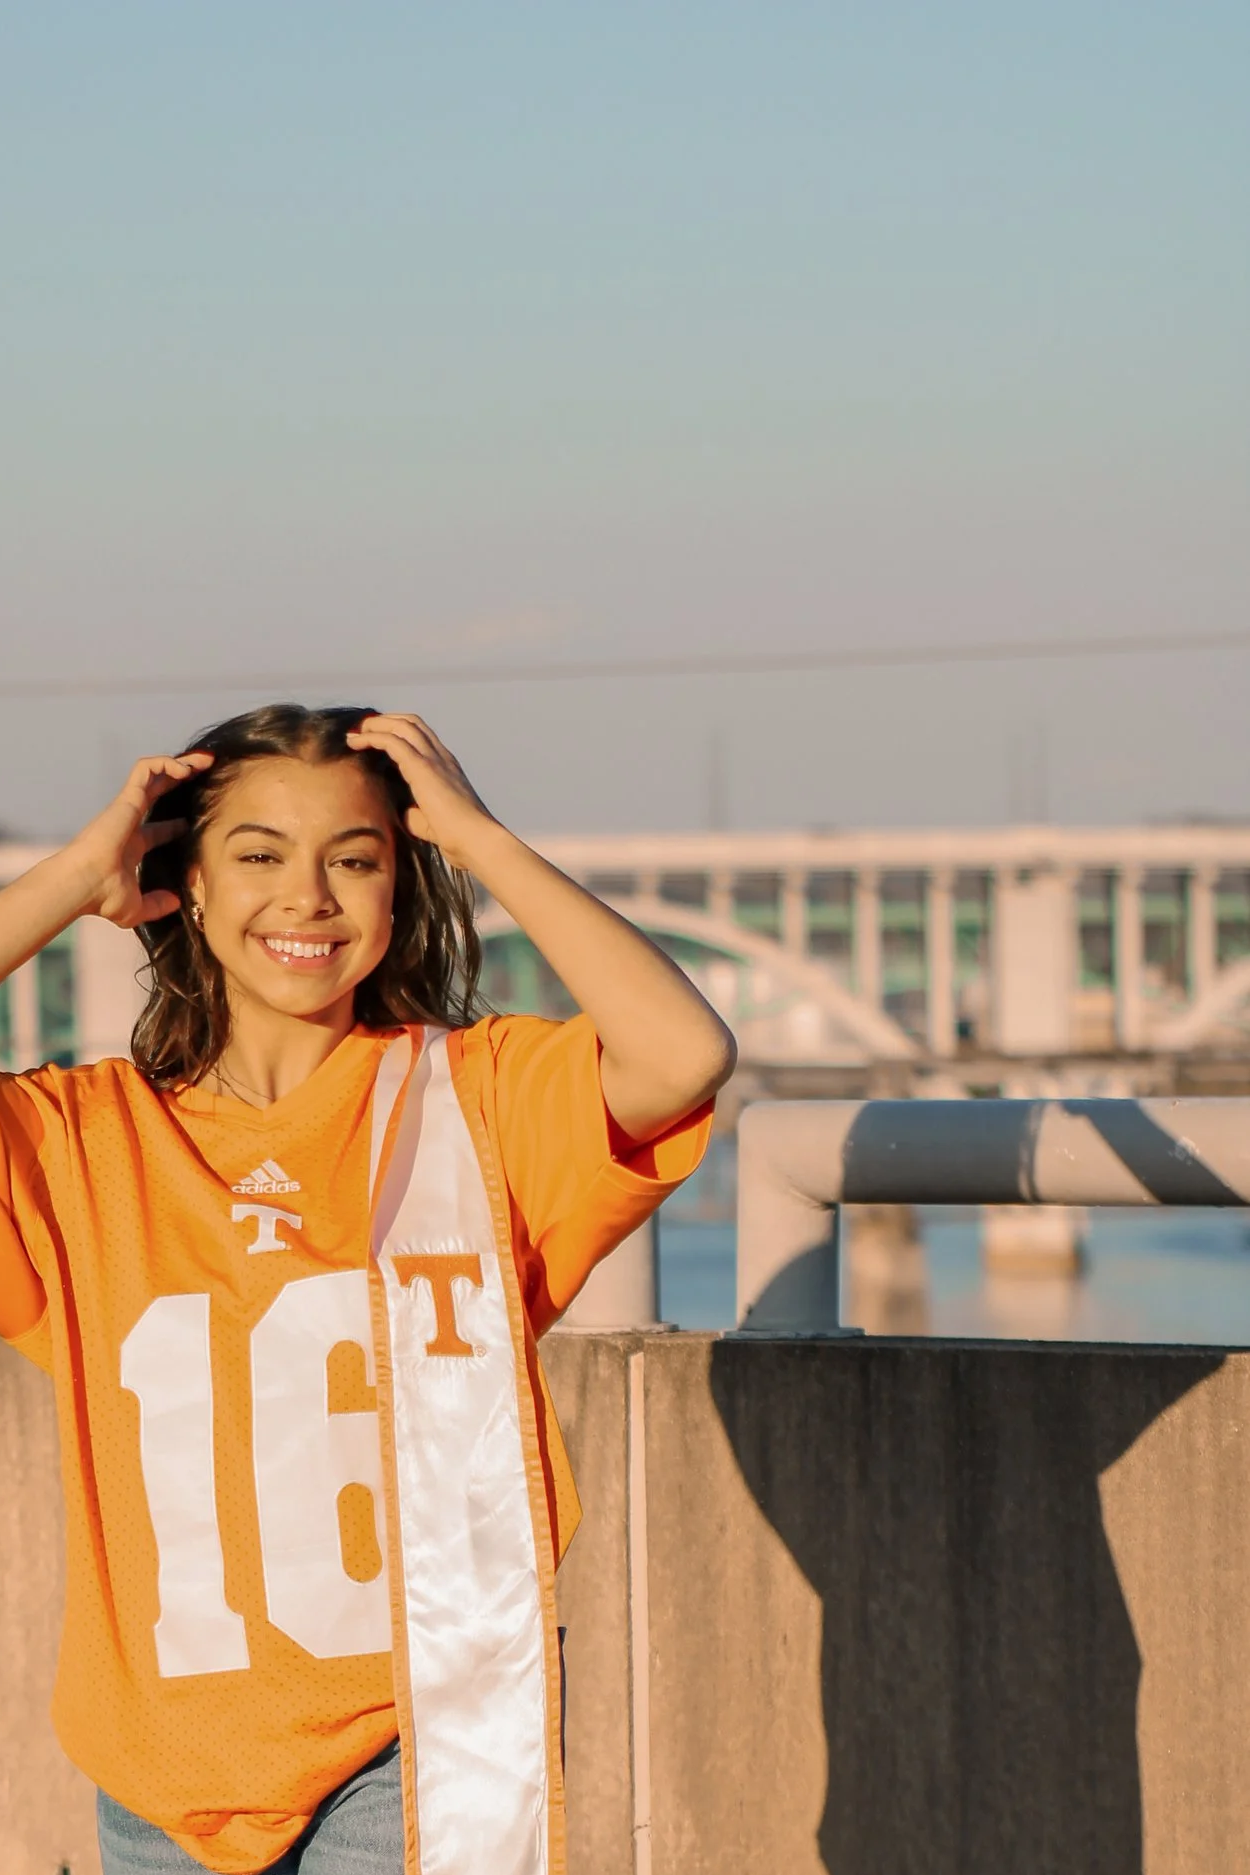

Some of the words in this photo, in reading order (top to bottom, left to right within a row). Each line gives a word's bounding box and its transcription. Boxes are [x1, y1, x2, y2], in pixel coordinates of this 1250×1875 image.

[231, 1178, 301, 1195] adidas
[231, 1203, 303, 1255] T
[390, 1253, 484, 1358] T
[120, 1268, 392, 1679] 16
